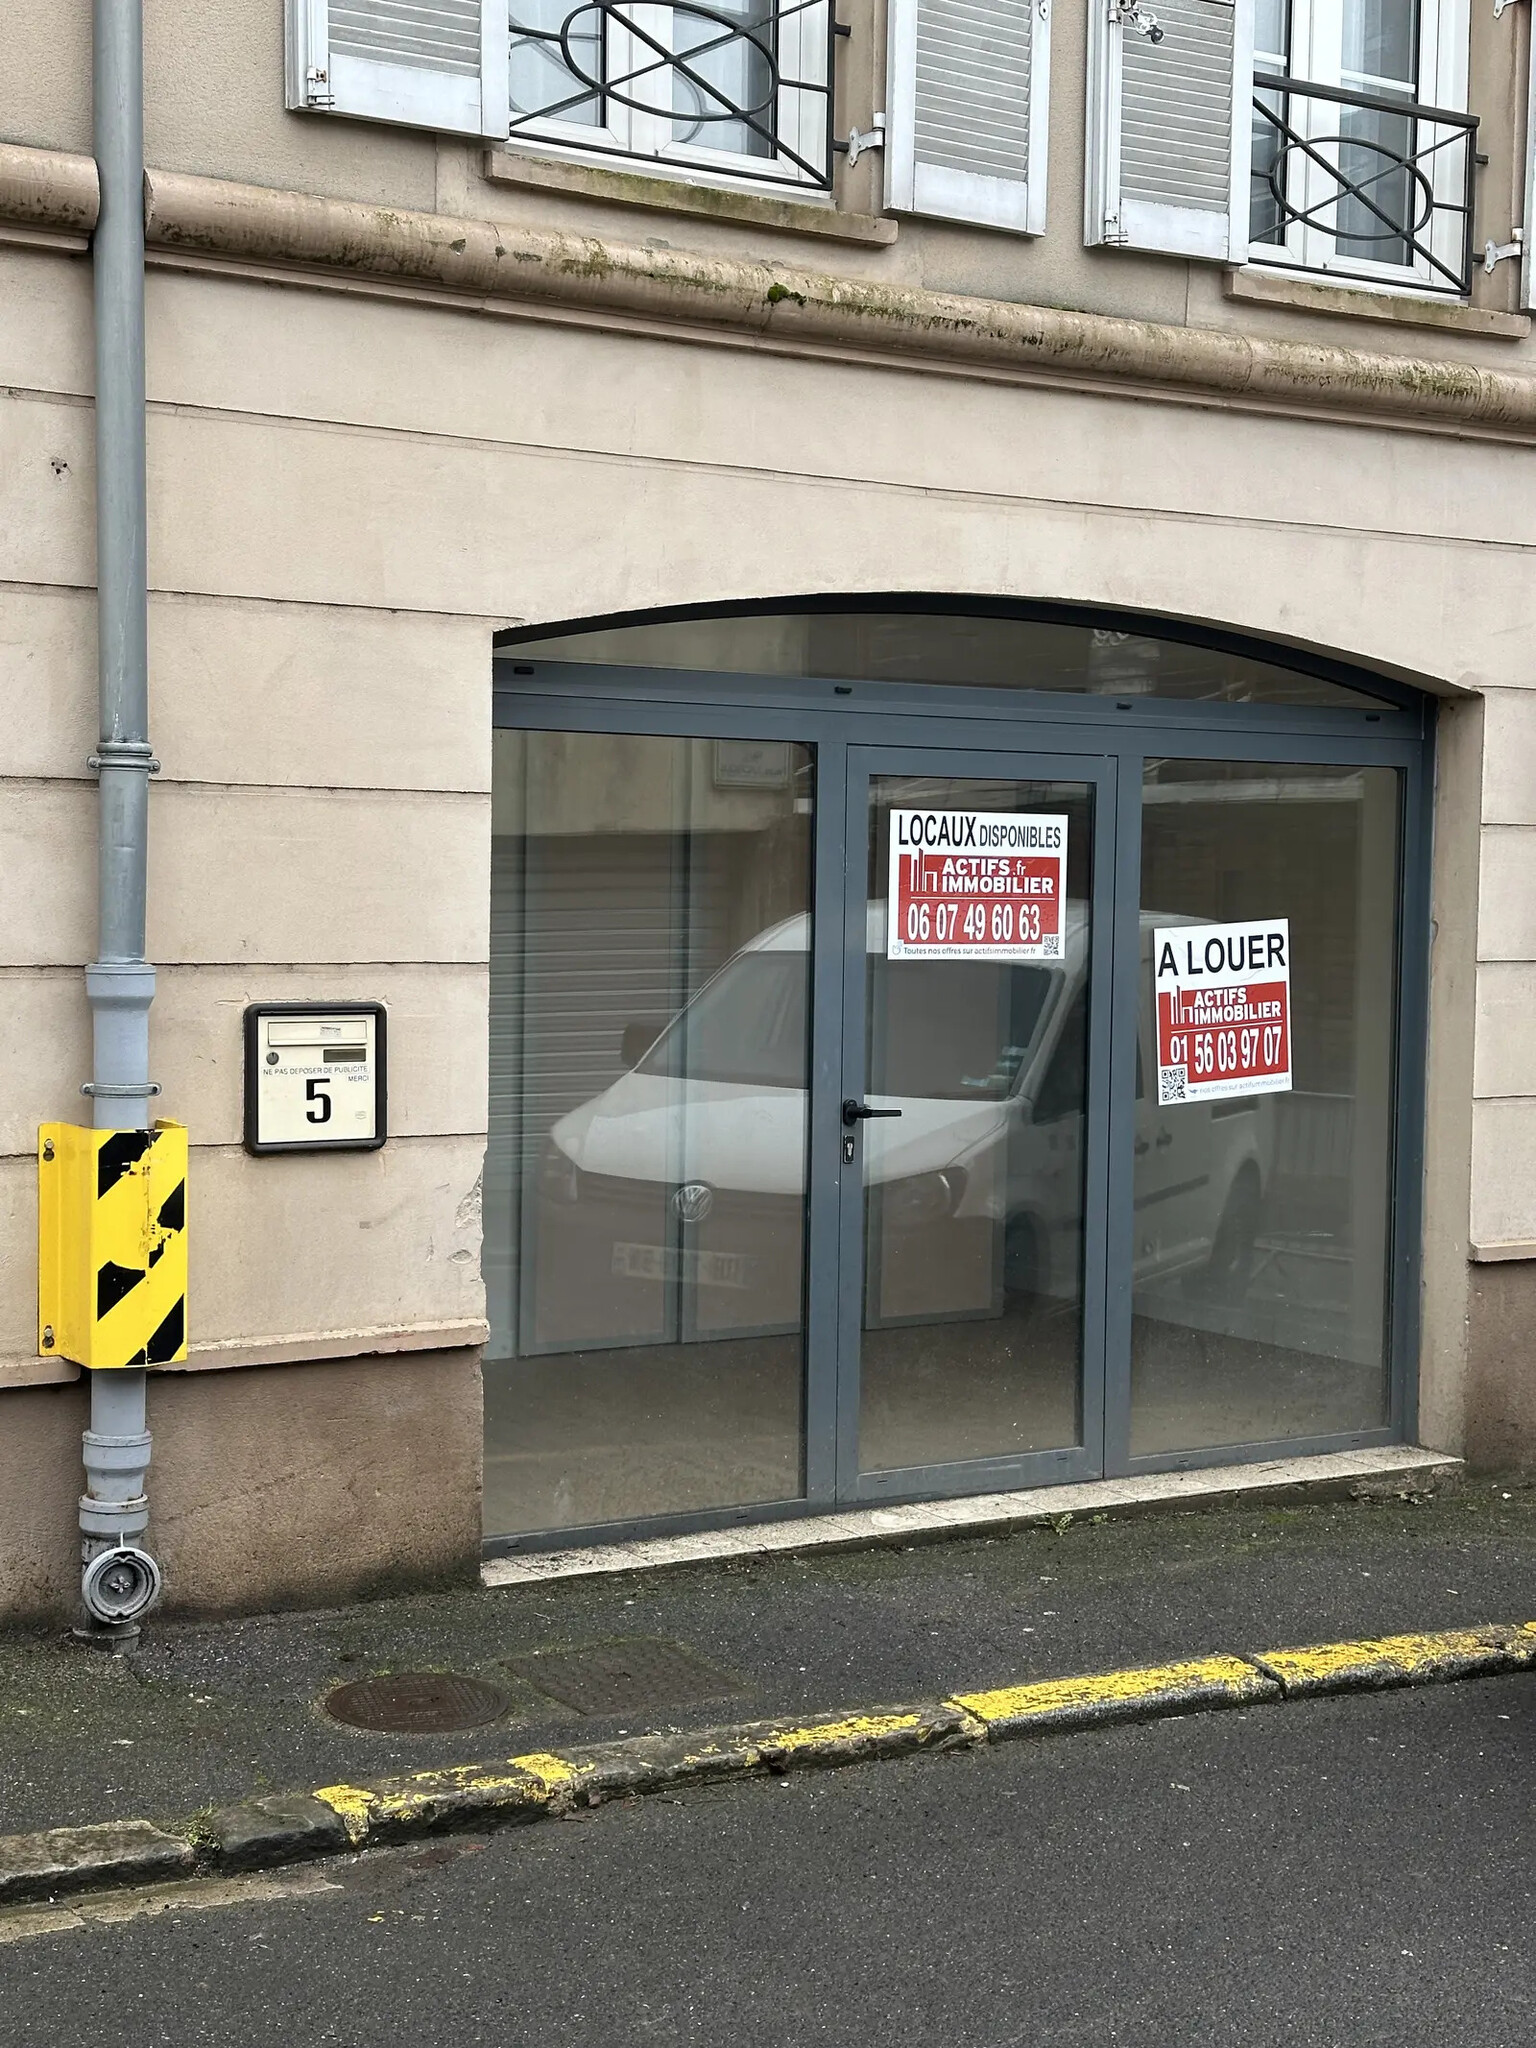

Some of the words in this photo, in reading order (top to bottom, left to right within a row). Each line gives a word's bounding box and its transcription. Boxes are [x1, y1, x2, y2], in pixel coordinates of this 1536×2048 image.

[899, 814, 977, 847] LOCAUX
[979, 825, 1061, 849] DISPONIBLES
[942, 858, 1010, 876] ACTIFS
[942, 875, 1054, 894] IMMOBILIER
[907, 903, 930, 941] 06
[936, 903, 959, 941] 07
[963, 903, 986, 941] 49
[991, 903, 1014, 941] 60
[1019, 904, 1041, 941] 63
[904, 946, 927, 955] Toutes
[941, 946, 961, 955] offres
[1157, 942, 1179, 977] A
[1187, 933, 1286, 975] LOUER
[1194, 987, 1247, 1009] ACTIFS
[1194, 1001, 1282, 1025] IMMOBILIER
[1170, 1035, 1188, 1064] 01
[1194, 1032, 1214, 1074] 56
[1217, 1030, 1237, 1072] 03
[1241, 1028, 1259, 1069] 97
[1263, 1025, 1282, 1067] 07
[263, 1068, 273, 1076] NE
[274, 1068, 288, 1076] PAS
[289, 1067, 323, 1075] DEPOSER
[323, 1066, 333, 1074] DE
[334, 1065, 368, 1073] PUBLICITE
[306, 1078, 332, 1124] 5
